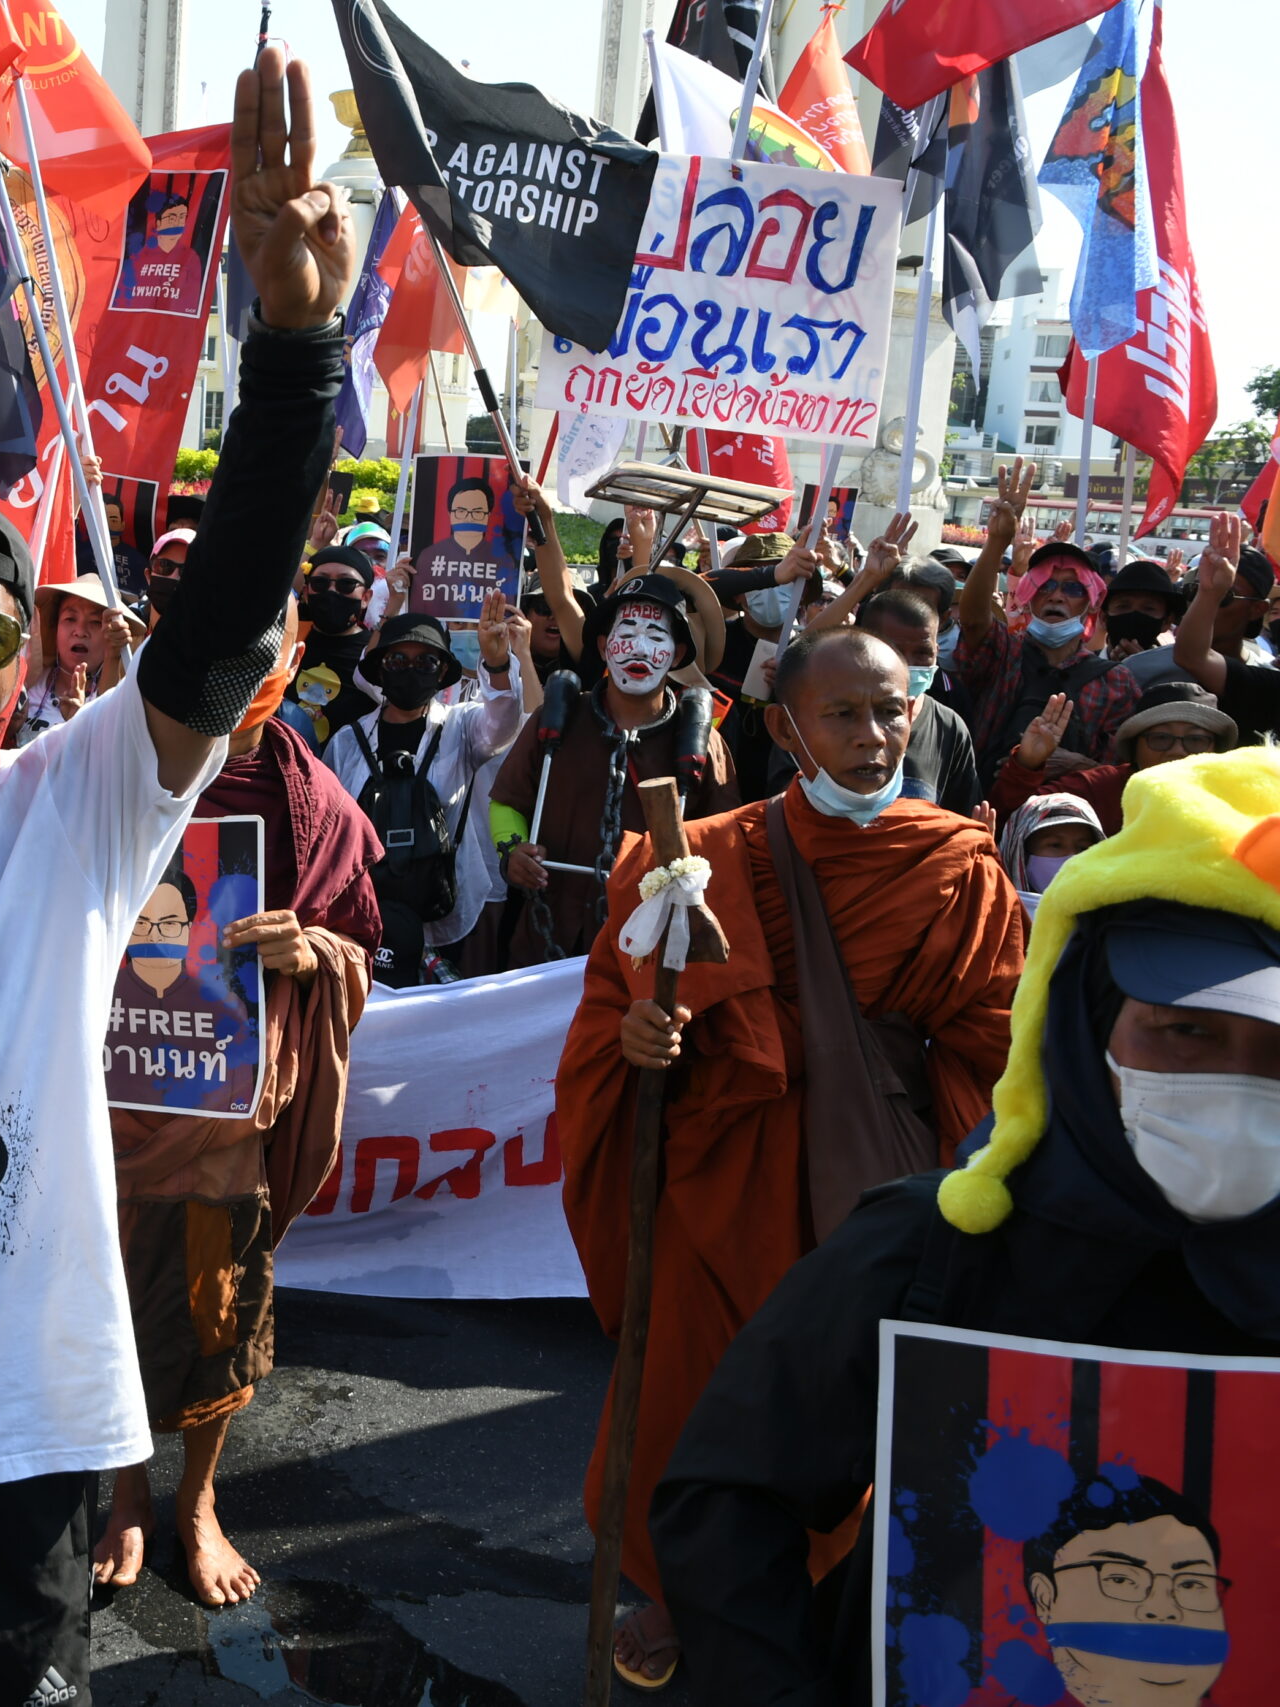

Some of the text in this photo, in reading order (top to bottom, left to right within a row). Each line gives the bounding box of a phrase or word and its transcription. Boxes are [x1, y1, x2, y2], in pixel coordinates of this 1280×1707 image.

[0, 67, 79, 91] REOLUTION
[447, 142, 610, 195] AGAINST
[441, 169, 599, 236] TORSHIP
[140, 263, 181, 278] #FREE
[831, 396, 878, 440] 112
[431, 555, 497, 580] #FREE
[107, 997, 215, 1039] #FREE
[230, 1102, 250, 1111] CrCF
[23, 1685, 77, 1707] adidas
